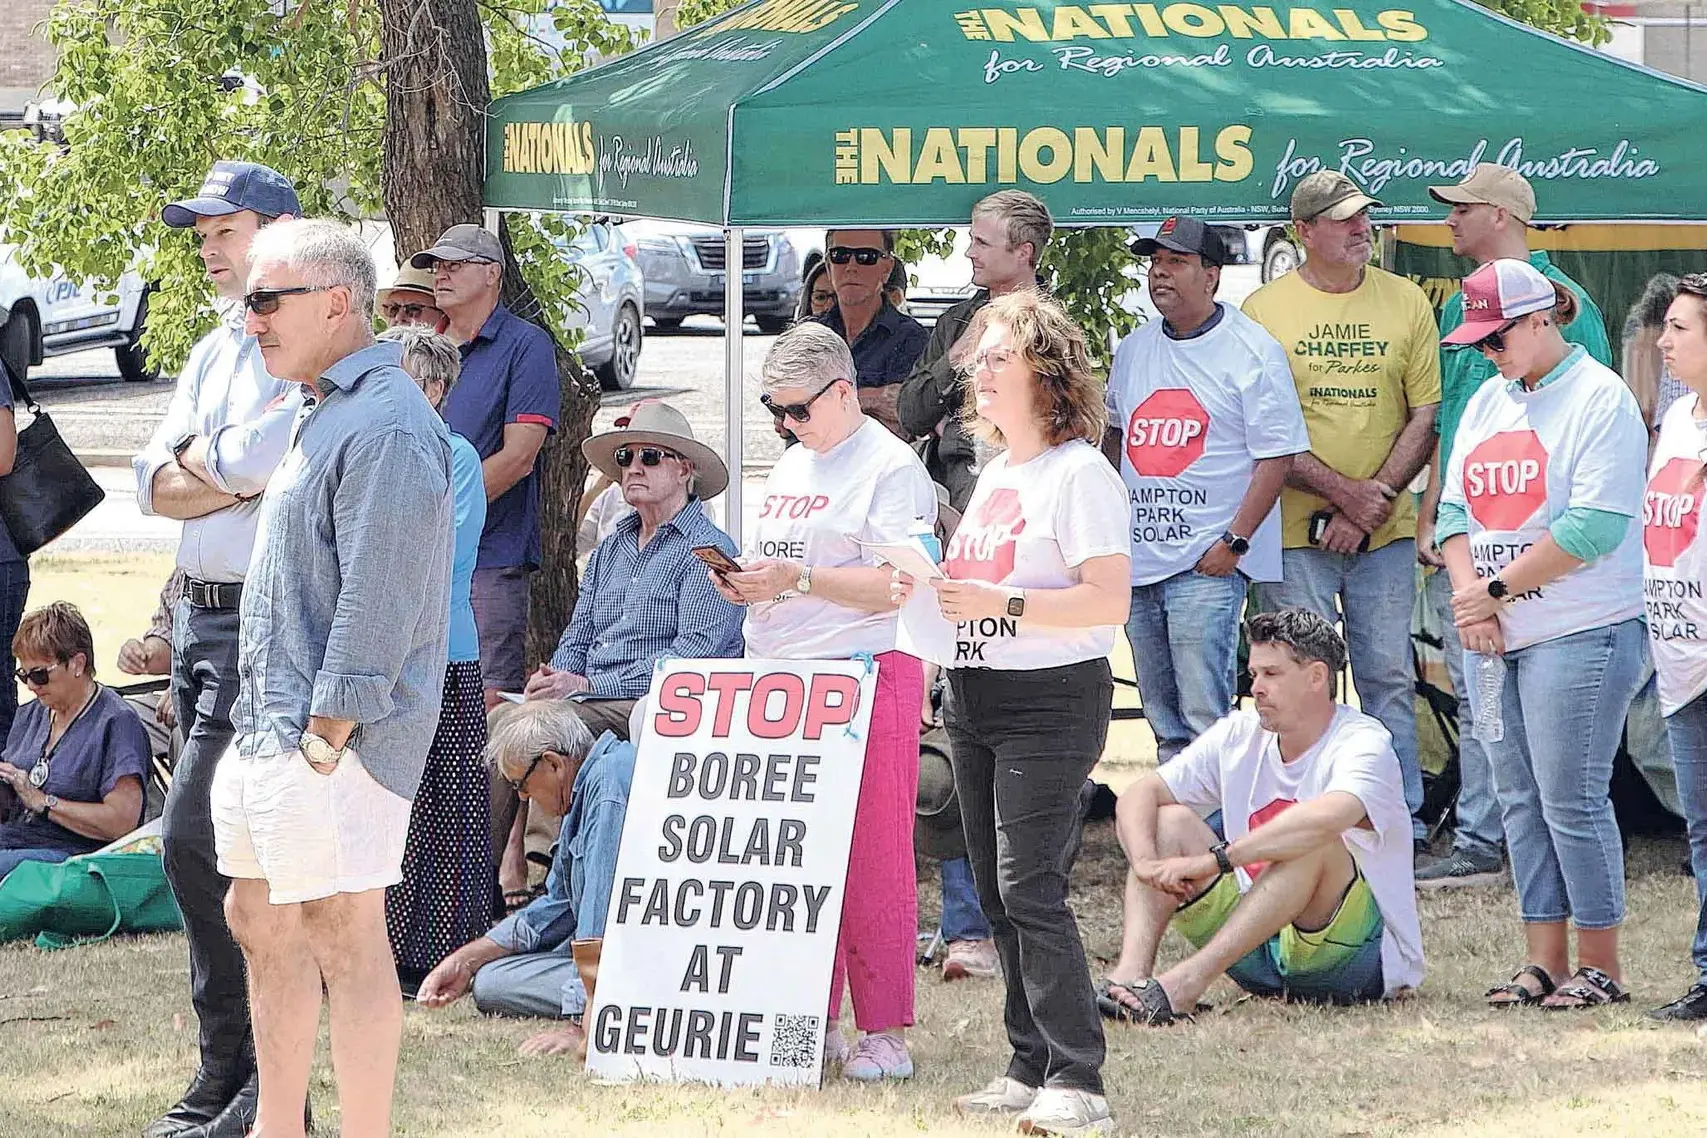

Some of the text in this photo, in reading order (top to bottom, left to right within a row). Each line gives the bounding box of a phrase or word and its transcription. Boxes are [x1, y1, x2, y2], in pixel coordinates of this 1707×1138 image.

[954, 3, 1428, 42] THE NATIONALS
[984, 44, 1444, 84] for Regional Australia
[510, 121, 595, 174] NATIONALS
[598, 135, 612, 190] for
[612, 136, 652, 190] Regional
[651, 136, 699, 177] Australia
[834, 125, 1255, 185] THE NATIONALS
[1271, 137, 1660, 199] for Regional Australia
[1071, 206, 1106, 215] Authorised
[1107, 207, 1115, 216] by
[1116, 207, 1122, 215] V
[1163, 206, 1190, 214] National
[1191, 206, 1208, 215] Party
[1209, 206, 1216, 214] of
[1217, 205, 1245, 213] Australia
[1251, 205, 1271, 214] NSW,
[1369, 206, 1392, 216] Sydney
[1393, 206, 1411, 214] NSW
[1294, 340, 1389, 358] CHAFFEY
[1308, 323, 1371, 340] JAMIE
[1308, 359, 1380, 374] for Parkes
[1314, 387, 1377, 398] NATIONALS
[1130, 417, 1202, 447] STOP
[1128, 488, 1206, 505] AMPTON
[1467, 459, 1540, 497] STOP
[759, 495, 829, 519] STOP
[1136, 507, 1185, 523] PARK
[1643, 491, 1695, 528] STOP
[1133, 525, 1193, 543] SOLAR
[955, 641, 987, 661] RK
[654, 671, 862, 740] STOP
[667, 752, 821, 803] BOREE
[658, 815, 807, 868] SOLAR
[616, 877, 832, 933] FACTORY
[680, 944, 744, 994] AT
[594, 1004, 764, 1063] GEURIE
